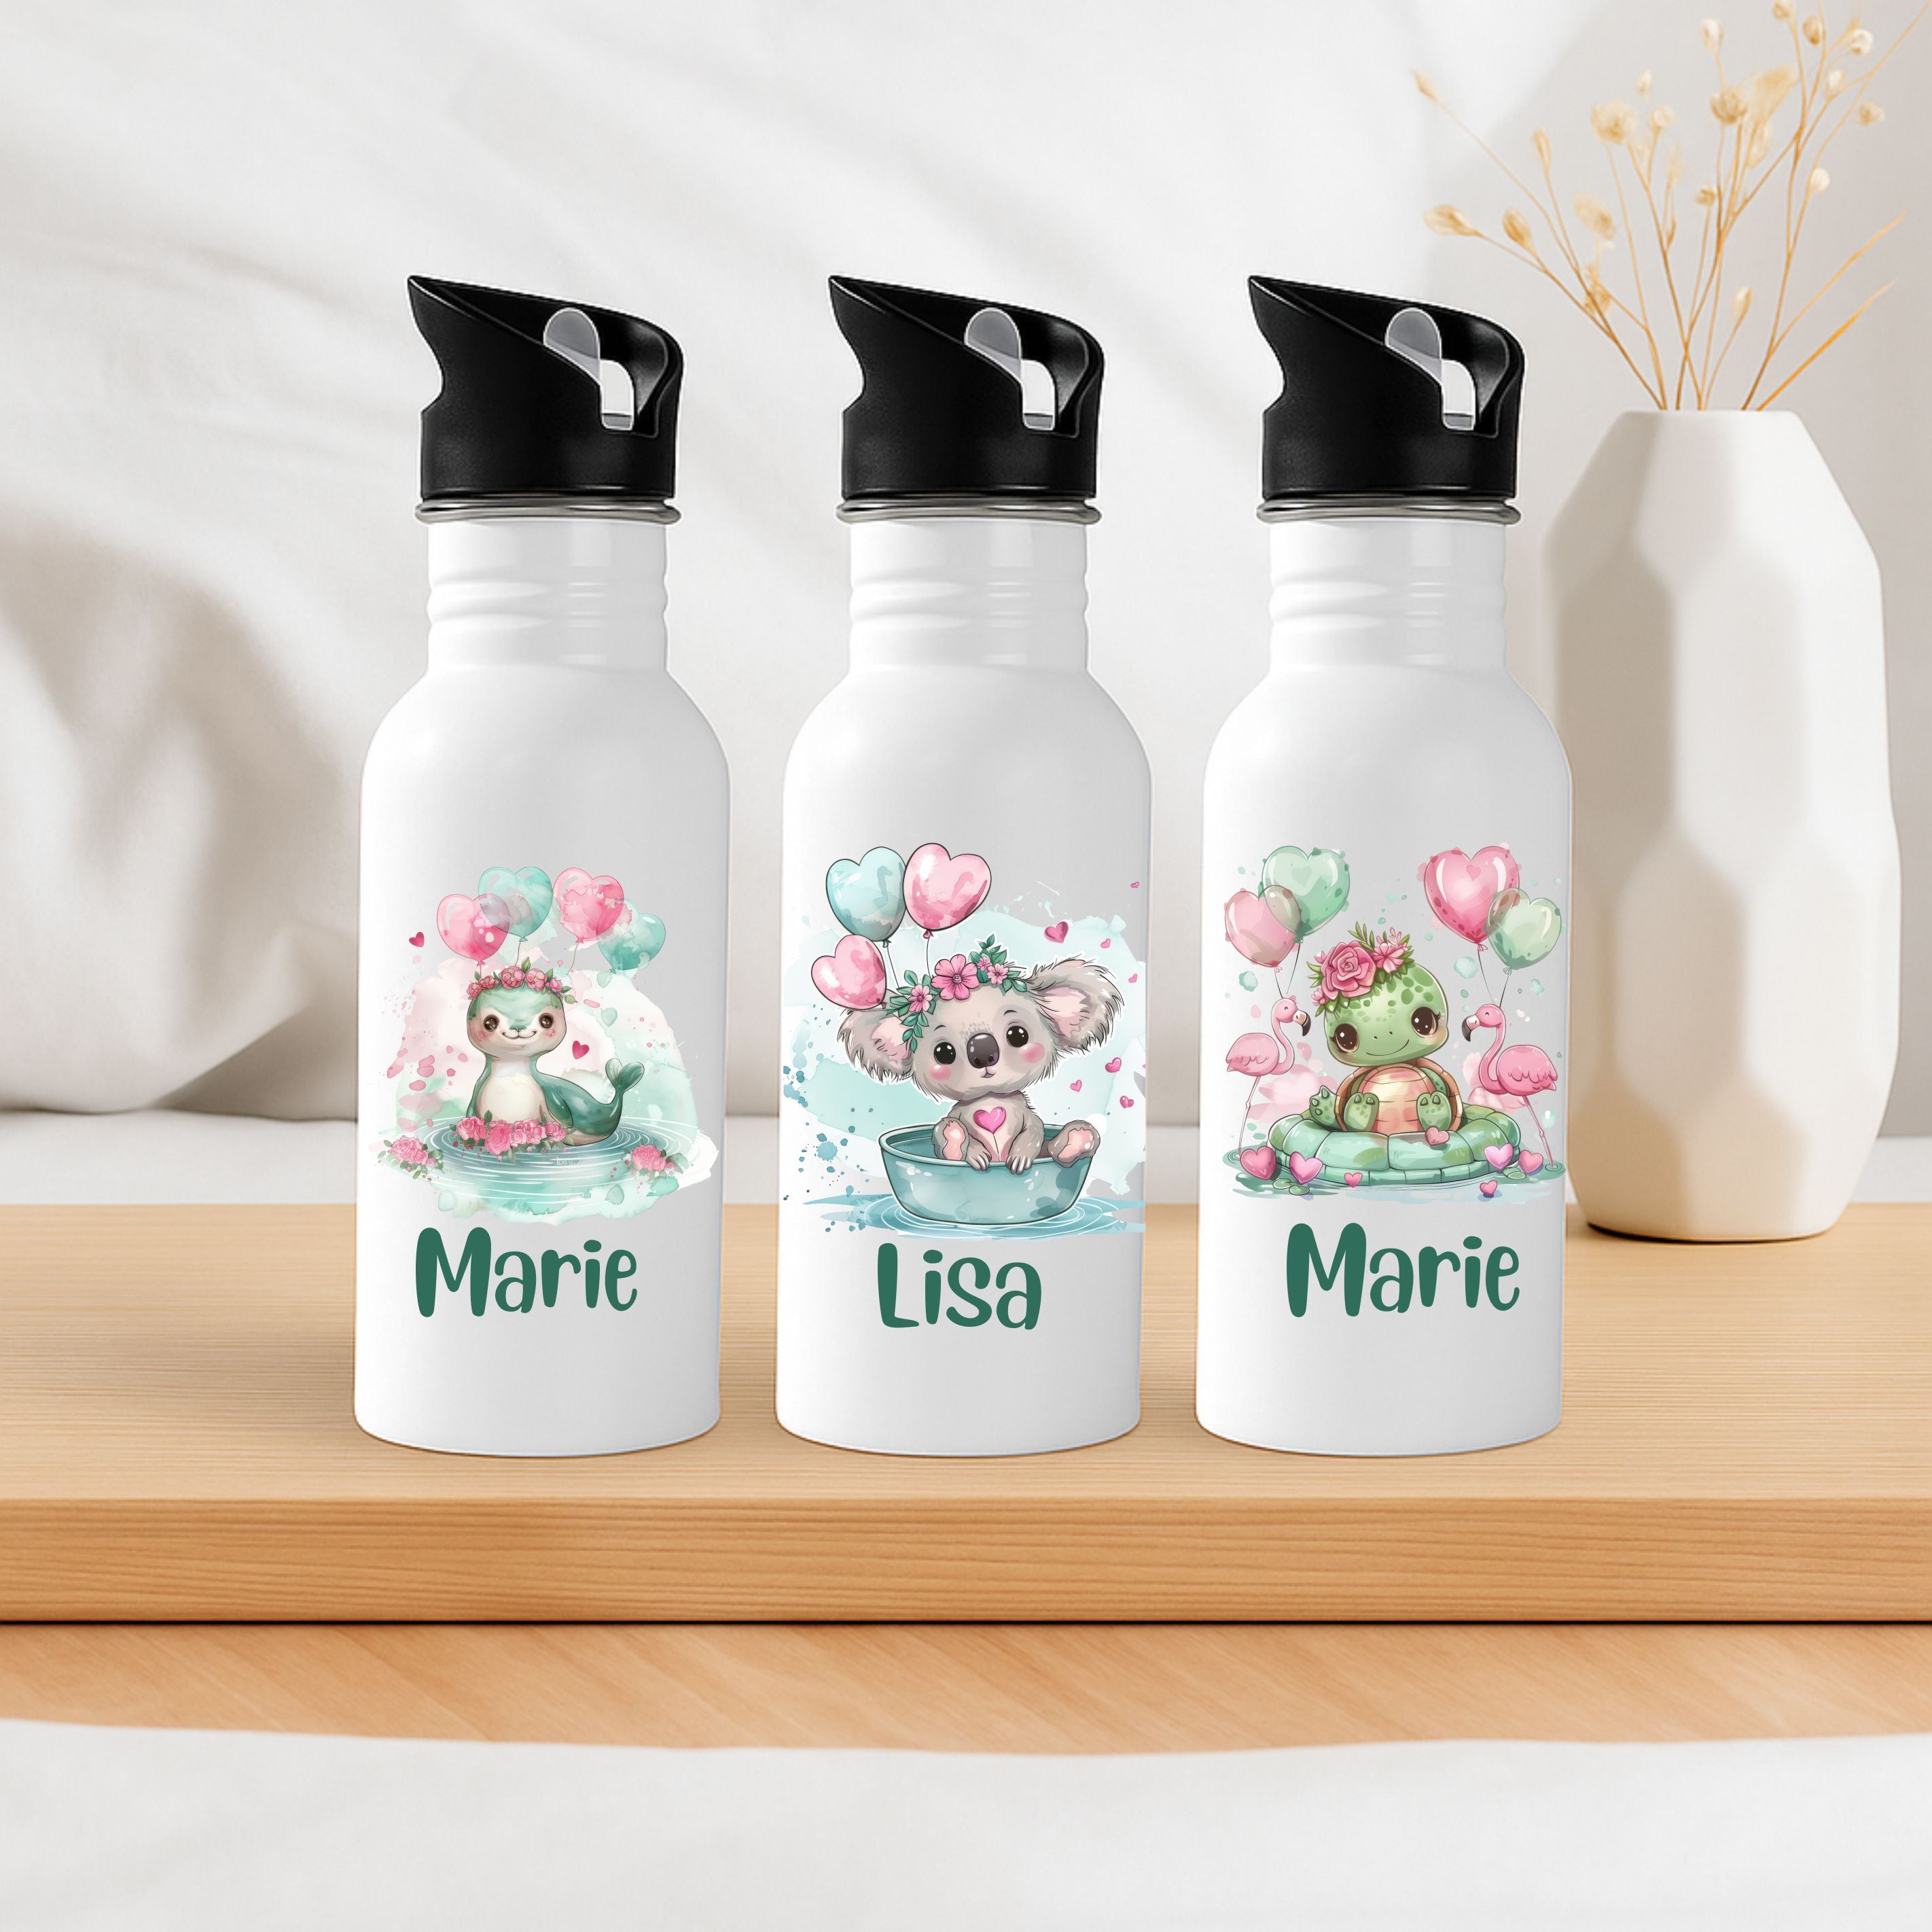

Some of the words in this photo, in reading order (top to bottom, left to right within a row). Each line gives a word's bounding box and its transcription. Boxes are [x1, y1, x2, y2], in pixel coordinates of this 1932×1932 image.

[416, 1228, 637, 1317] Marie
[878, 1242, 1041, 1330] Lisa
[1287, 1223, 1520, 1318] Marie
